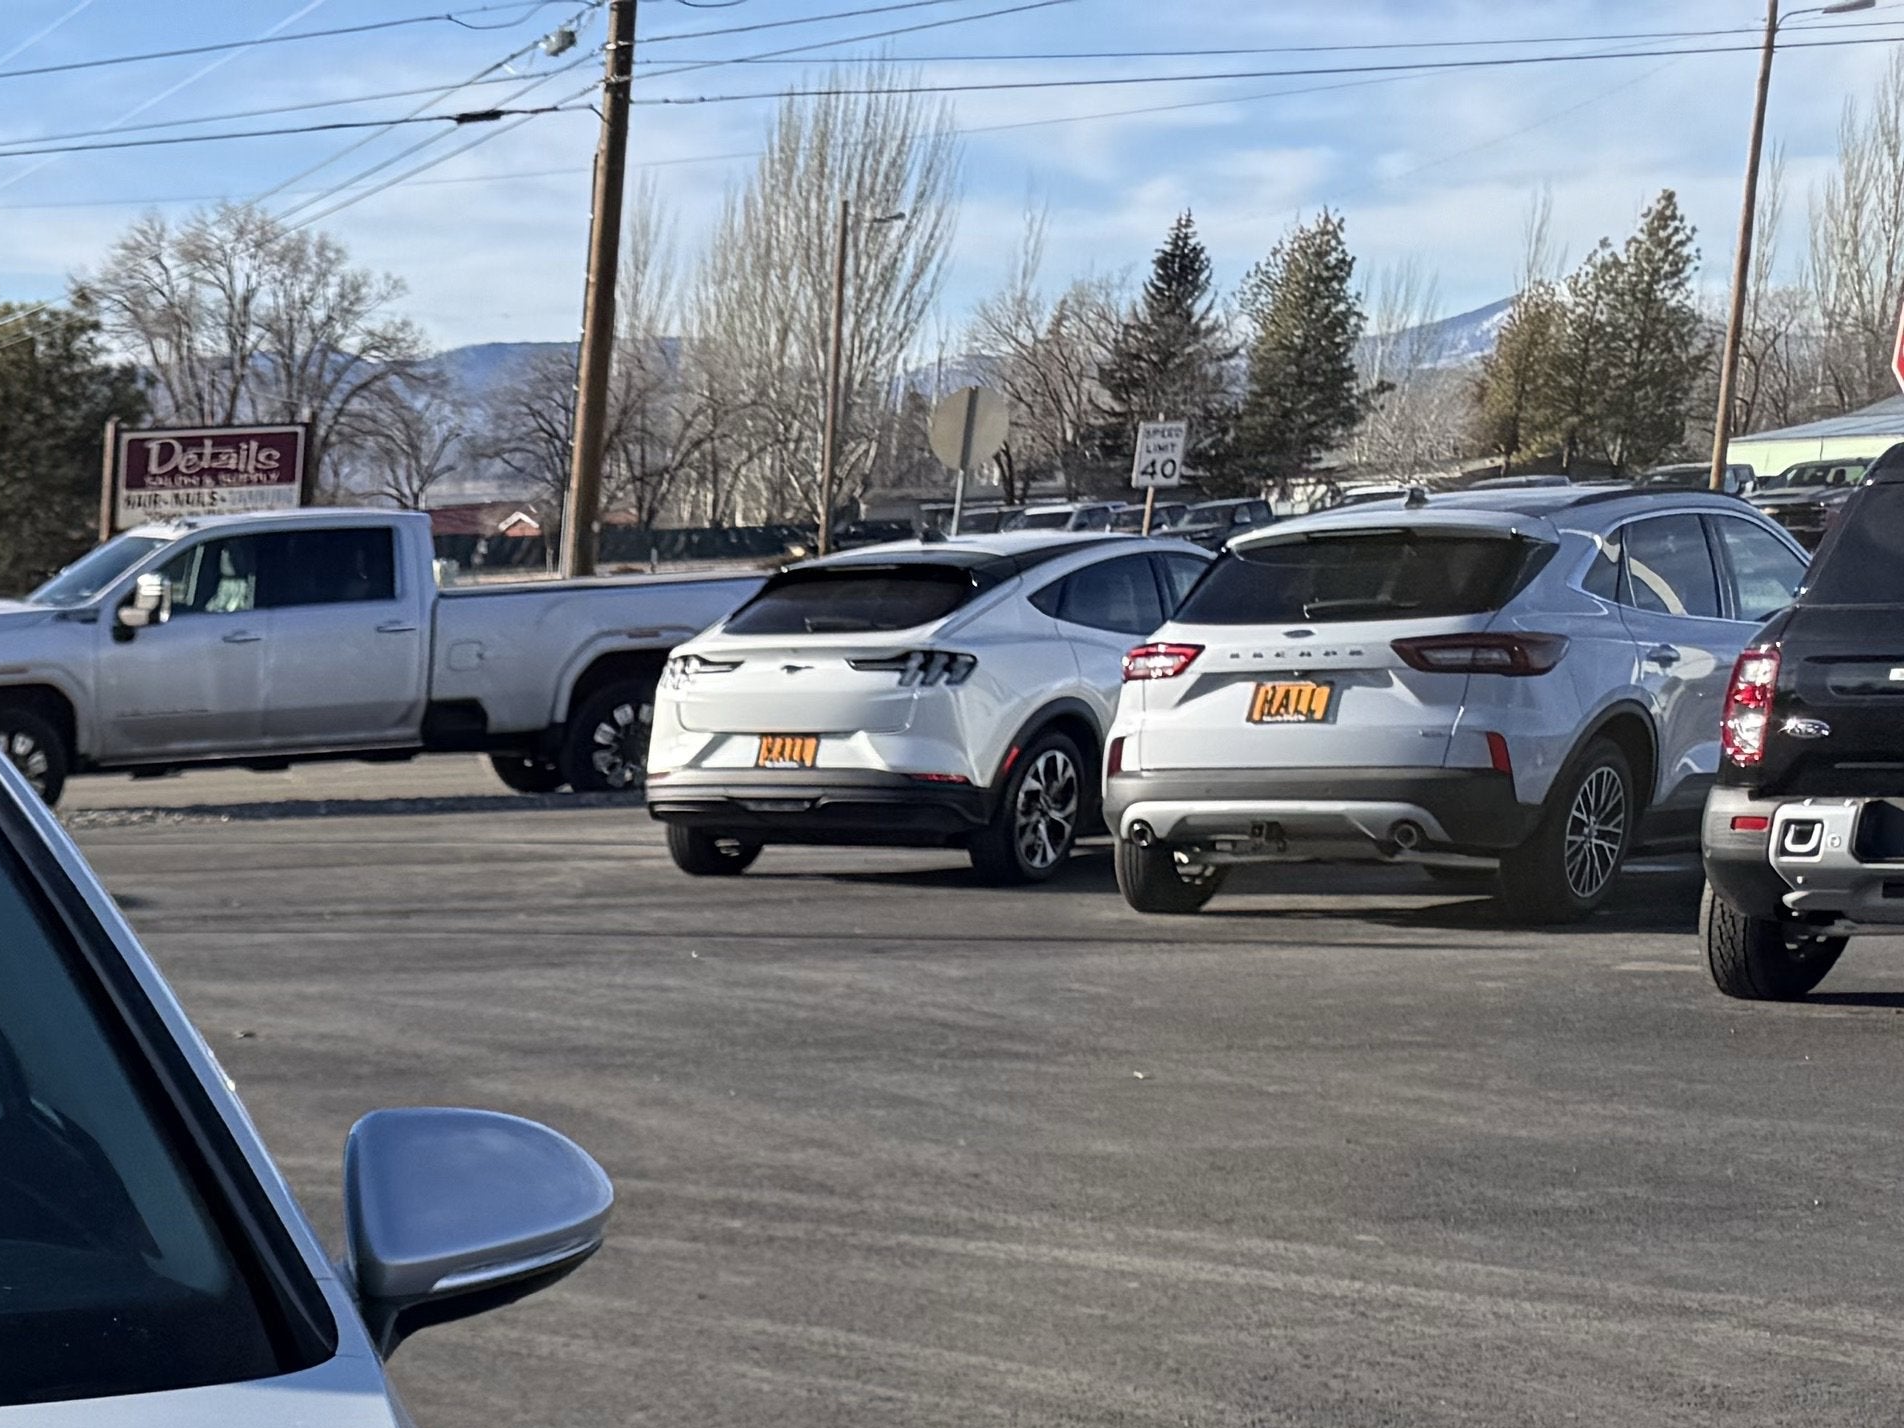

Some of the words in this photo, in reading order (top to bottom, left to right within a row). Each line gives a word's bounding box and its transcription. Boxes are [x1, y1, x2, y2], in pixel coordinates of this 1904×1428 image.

[143, 438, 281, 475] Details
[1141, 459, 1177, 480] 40
[1261, 685, 1317, 717] HALL
